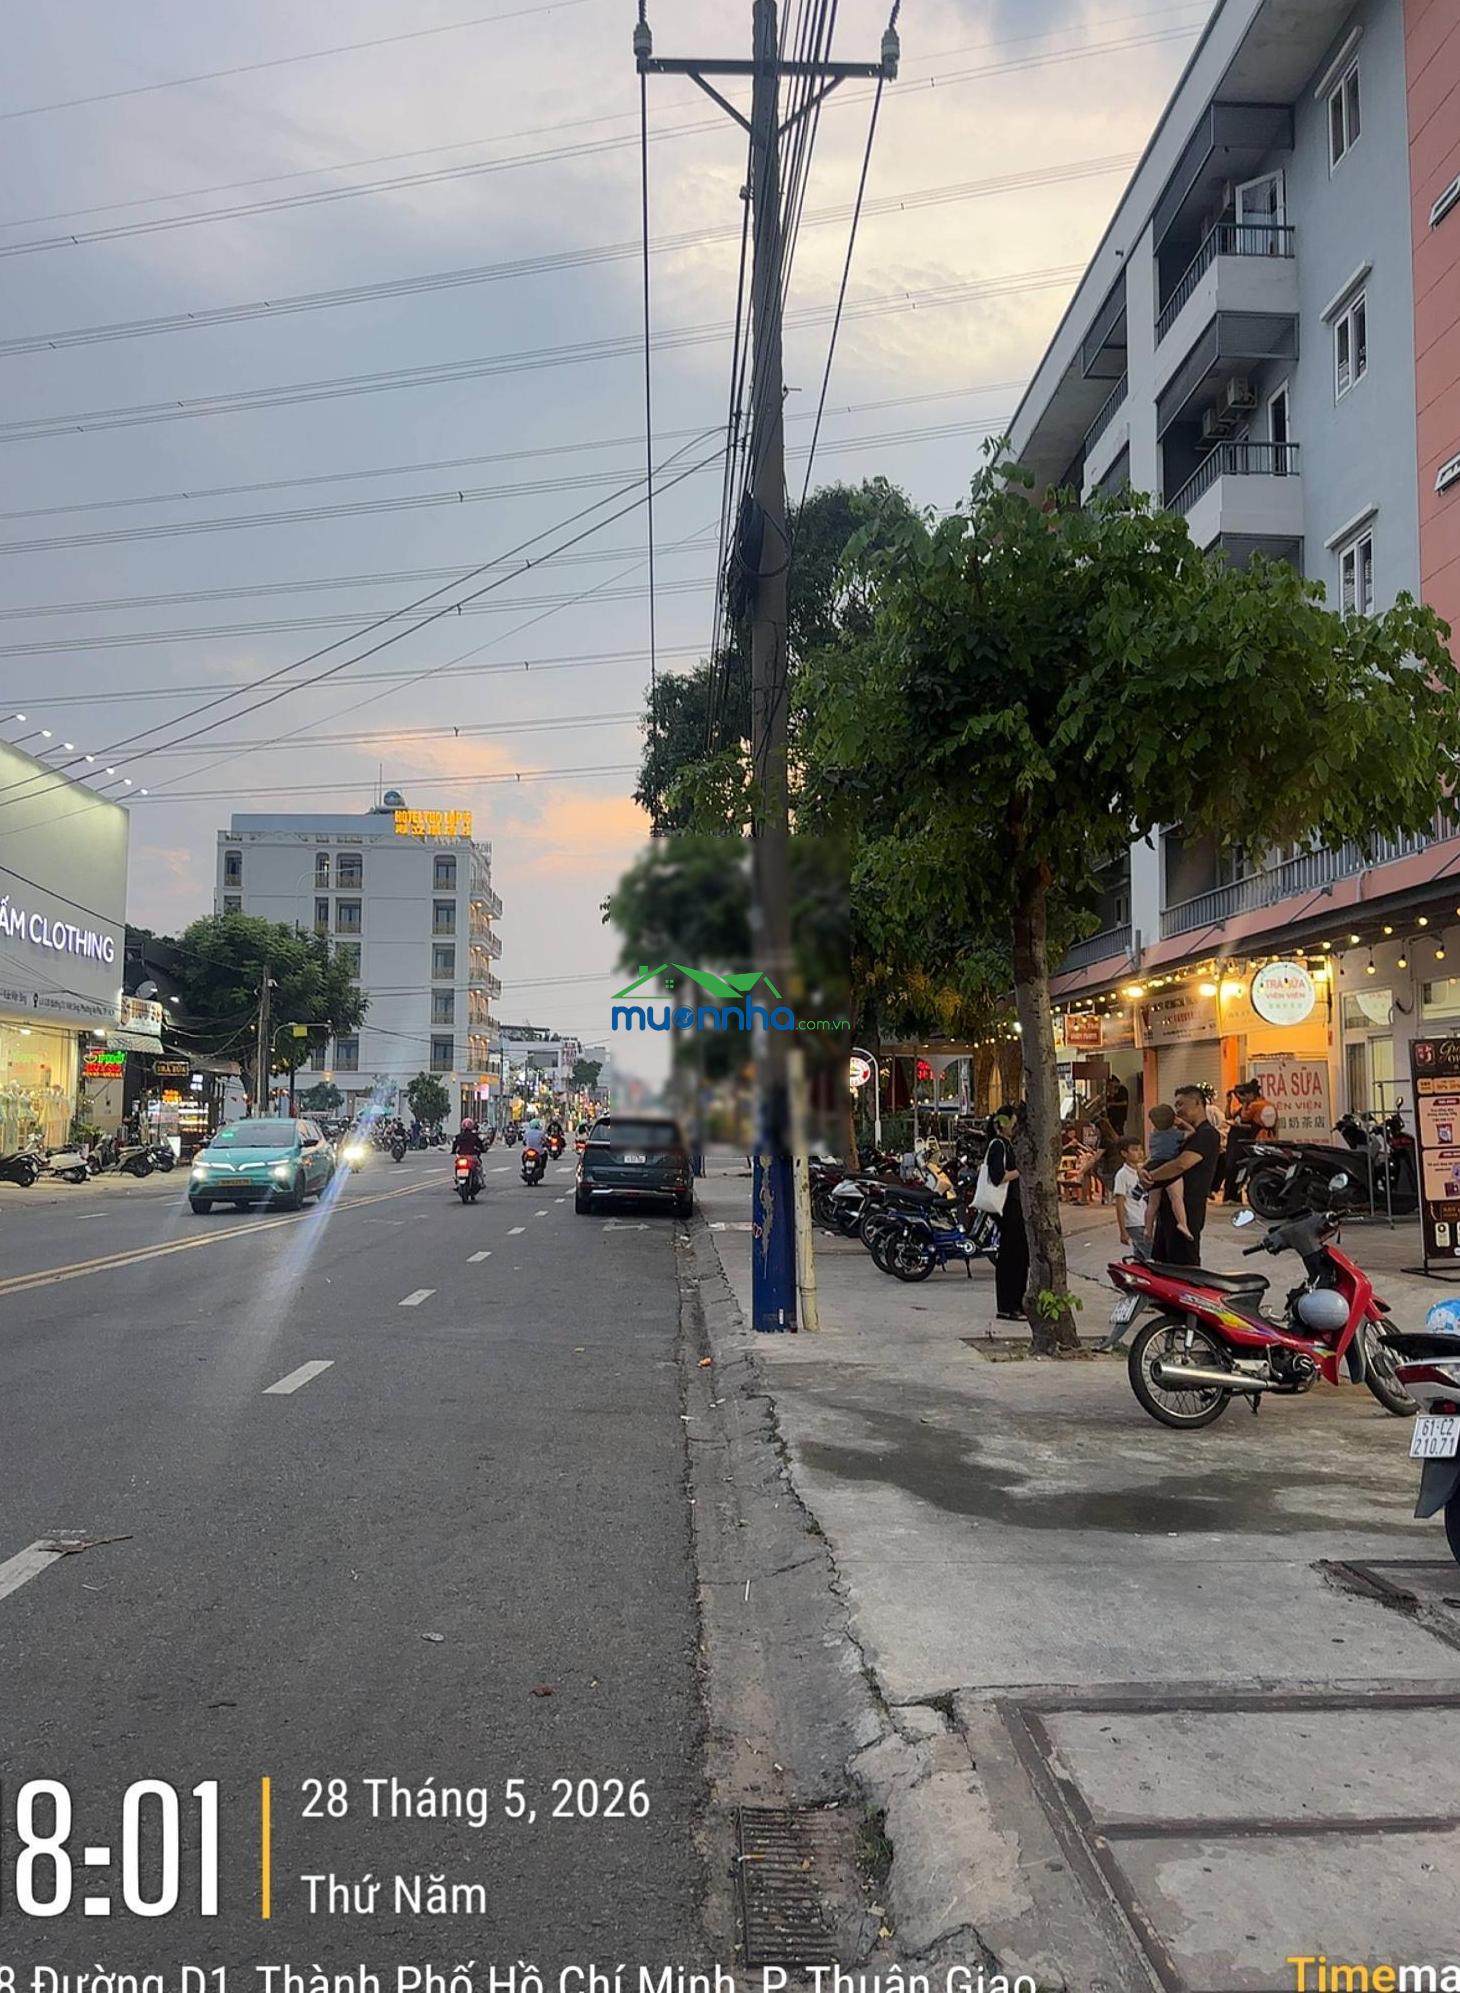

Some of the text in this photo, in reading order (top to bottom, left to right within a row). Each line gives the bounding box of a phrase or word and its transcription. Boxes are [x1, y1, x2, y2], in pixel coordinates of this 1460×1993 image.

[29, 913, 115, 963] CLOTHING
[1257, 1065, 1323, 1097] TRÀ SỮA
[1414, 1437, 1456, 1455] 210.71
